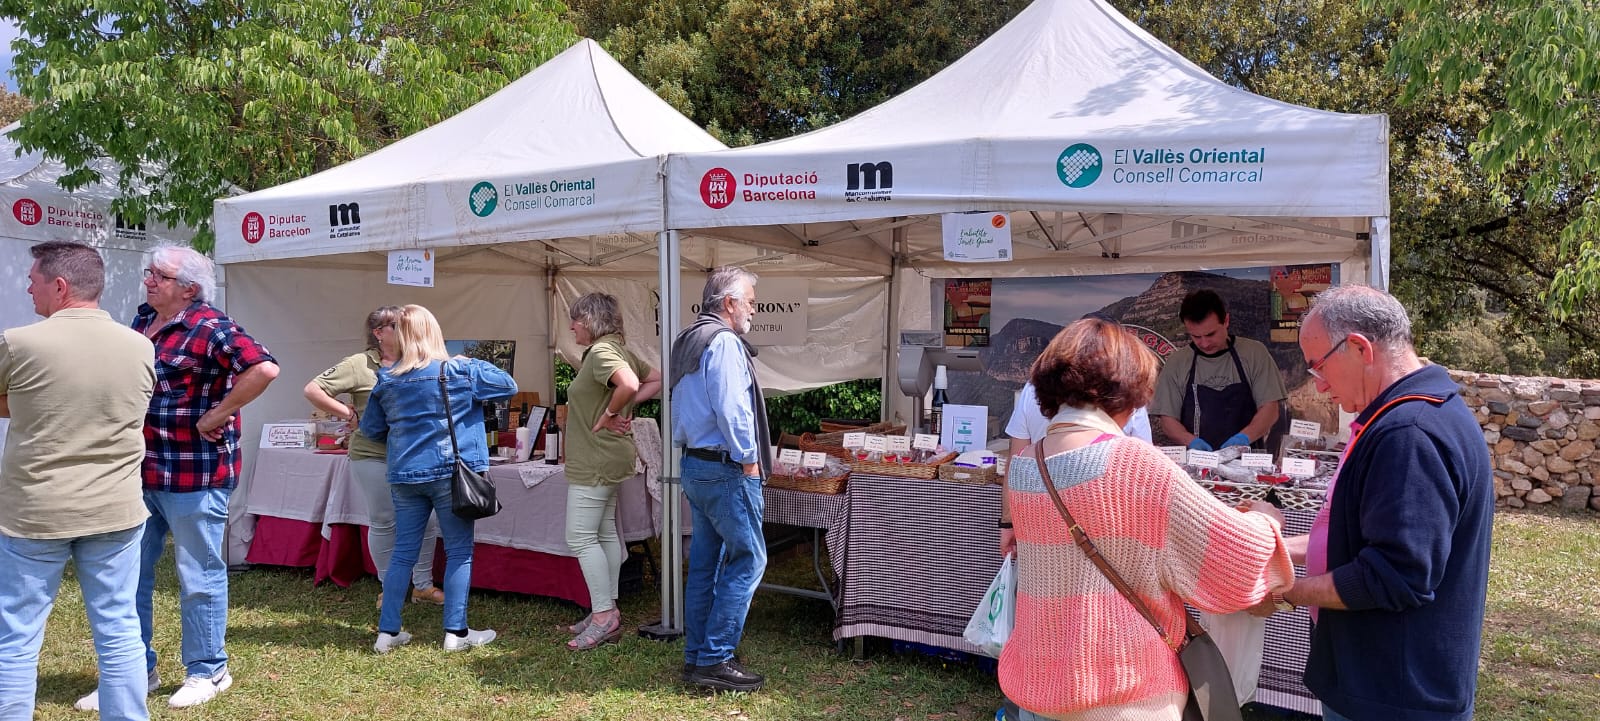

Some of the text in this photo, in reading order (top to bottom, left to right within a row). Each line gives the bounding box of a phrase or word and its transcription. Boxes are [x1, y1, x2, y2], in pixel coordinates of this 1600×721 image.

[1114, 147, 1265, 165] El Vallès Oriental
[743, 171, 818, 188] Diputació
[1113, 166, 1264, 185] Consell Comarcal
[504, 177, 595, 197] El Vallès Oriental
[743, 189, 816, 202] Barcelona
[504, 192, 596, 211] Consell Comarcal
